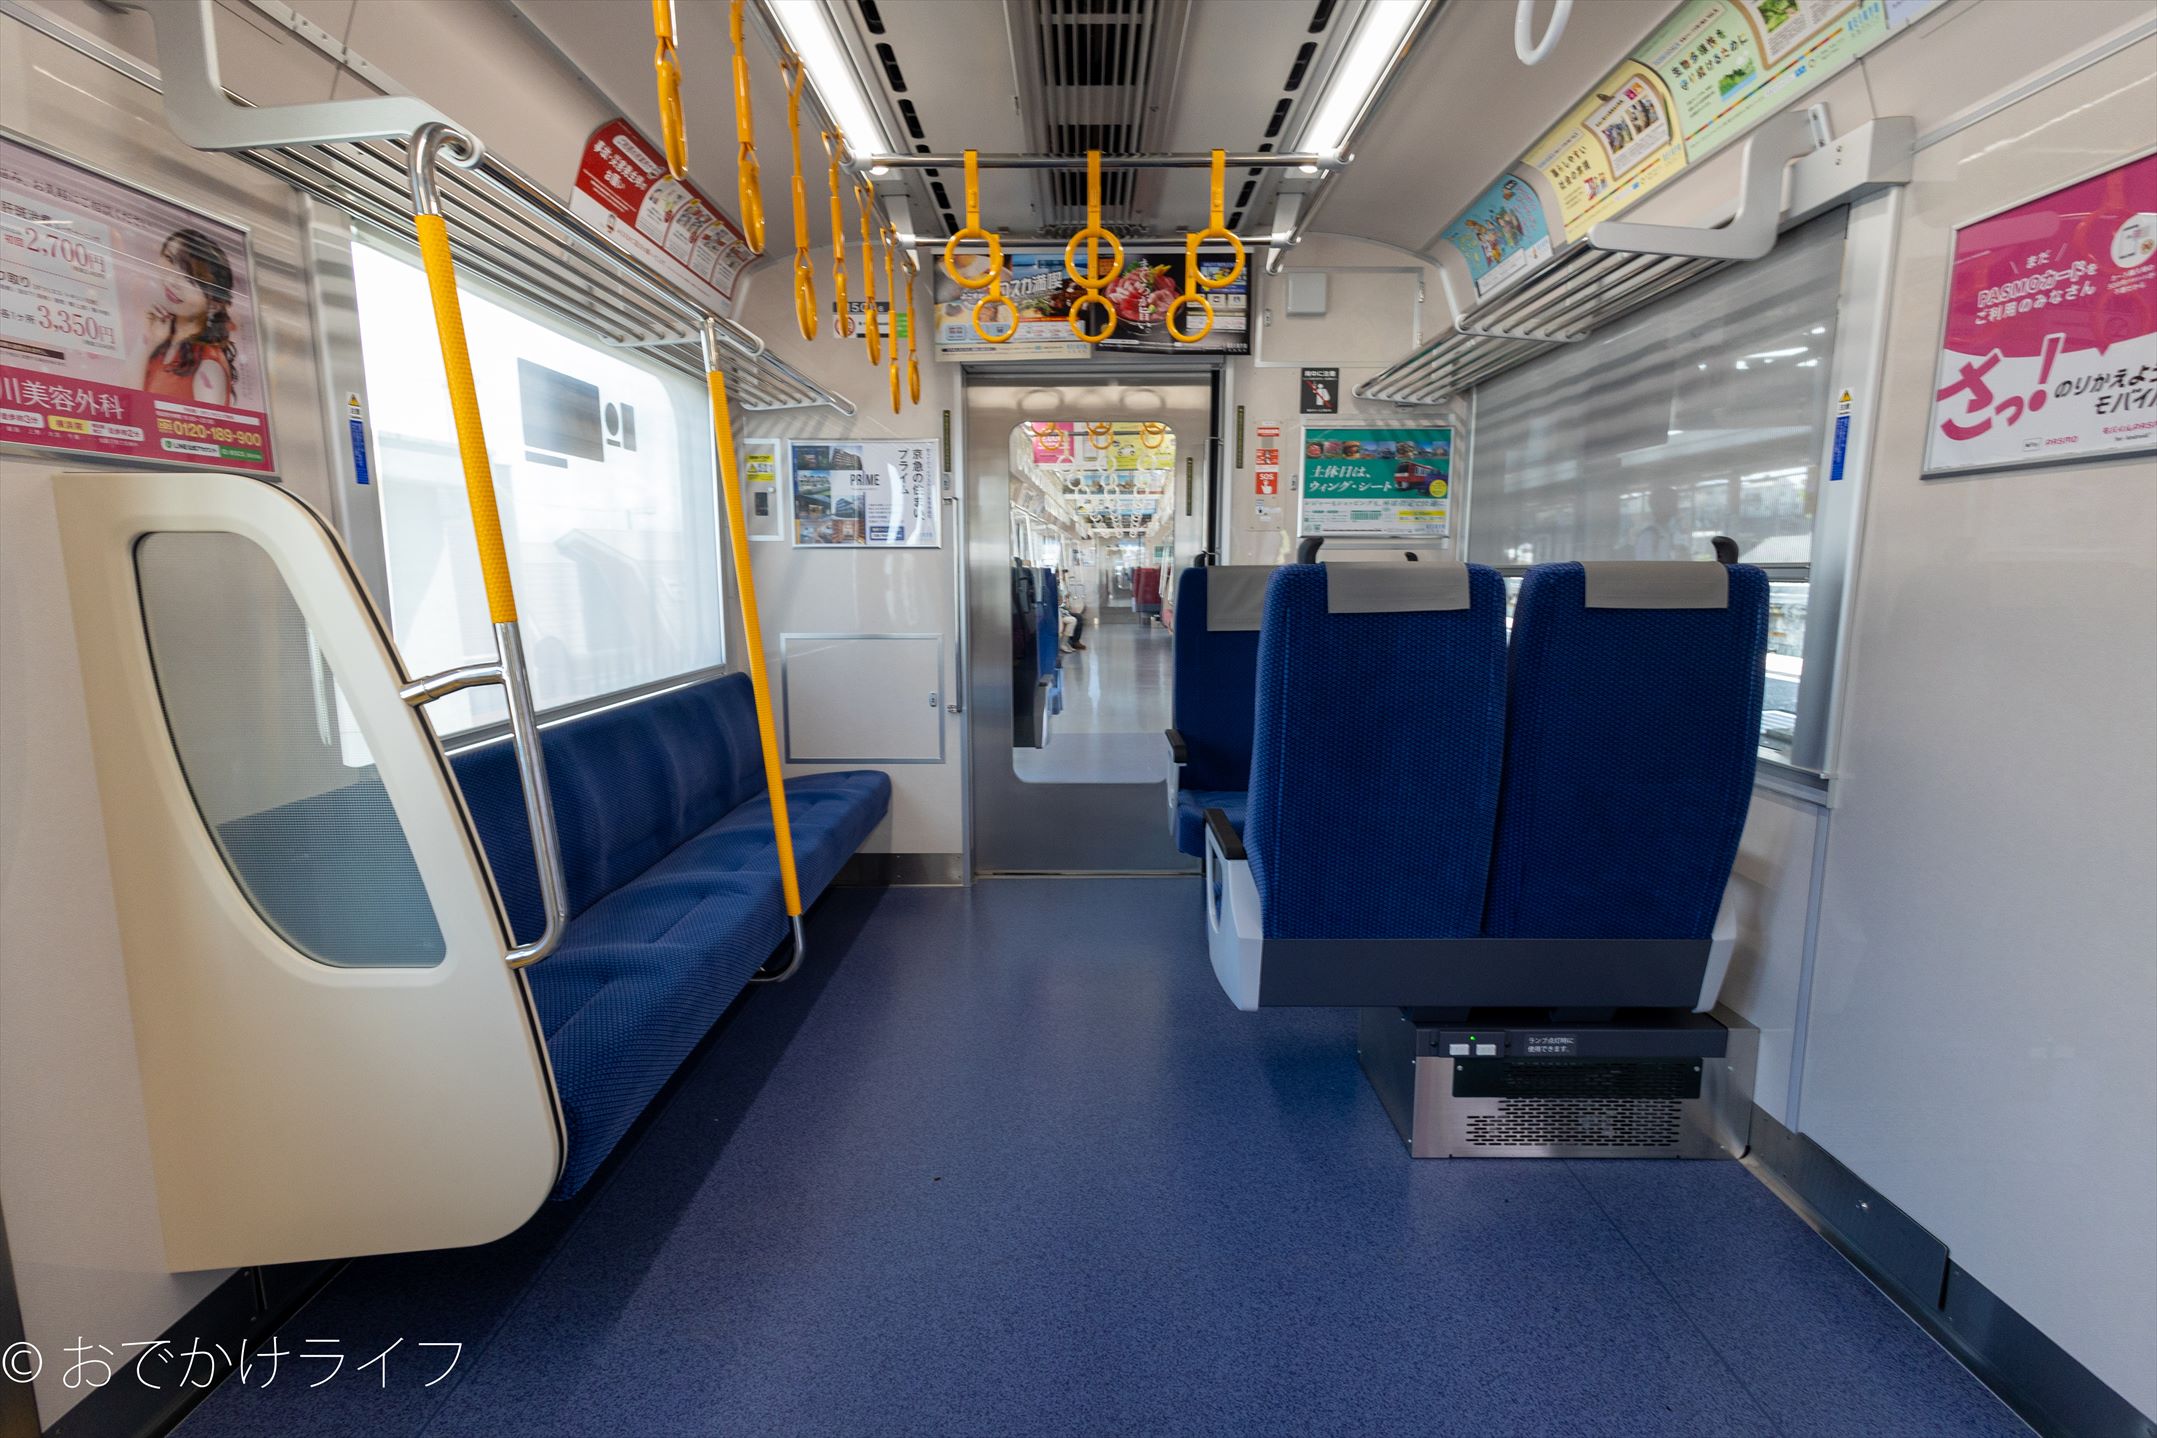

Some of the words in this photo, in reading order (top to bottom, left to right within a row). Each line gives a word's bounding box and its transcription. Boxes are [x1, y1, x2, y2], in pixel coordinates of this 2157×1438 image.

[2026, 250, 2052, 268] まだ
[1000, 271, 1063, 297] コスカ満喫
[1977, 260, 2097, 308] PASMOカードを
[1975, 280, 2096, 325] ご利用のみなさん
[37, 305, 115, 344] 3,350円
[850, 474, 880, 486] PRIME
[1310, 465, 1371, 478] 土休日は、
[1309, 481, 1393, 492] ウィング・シート
